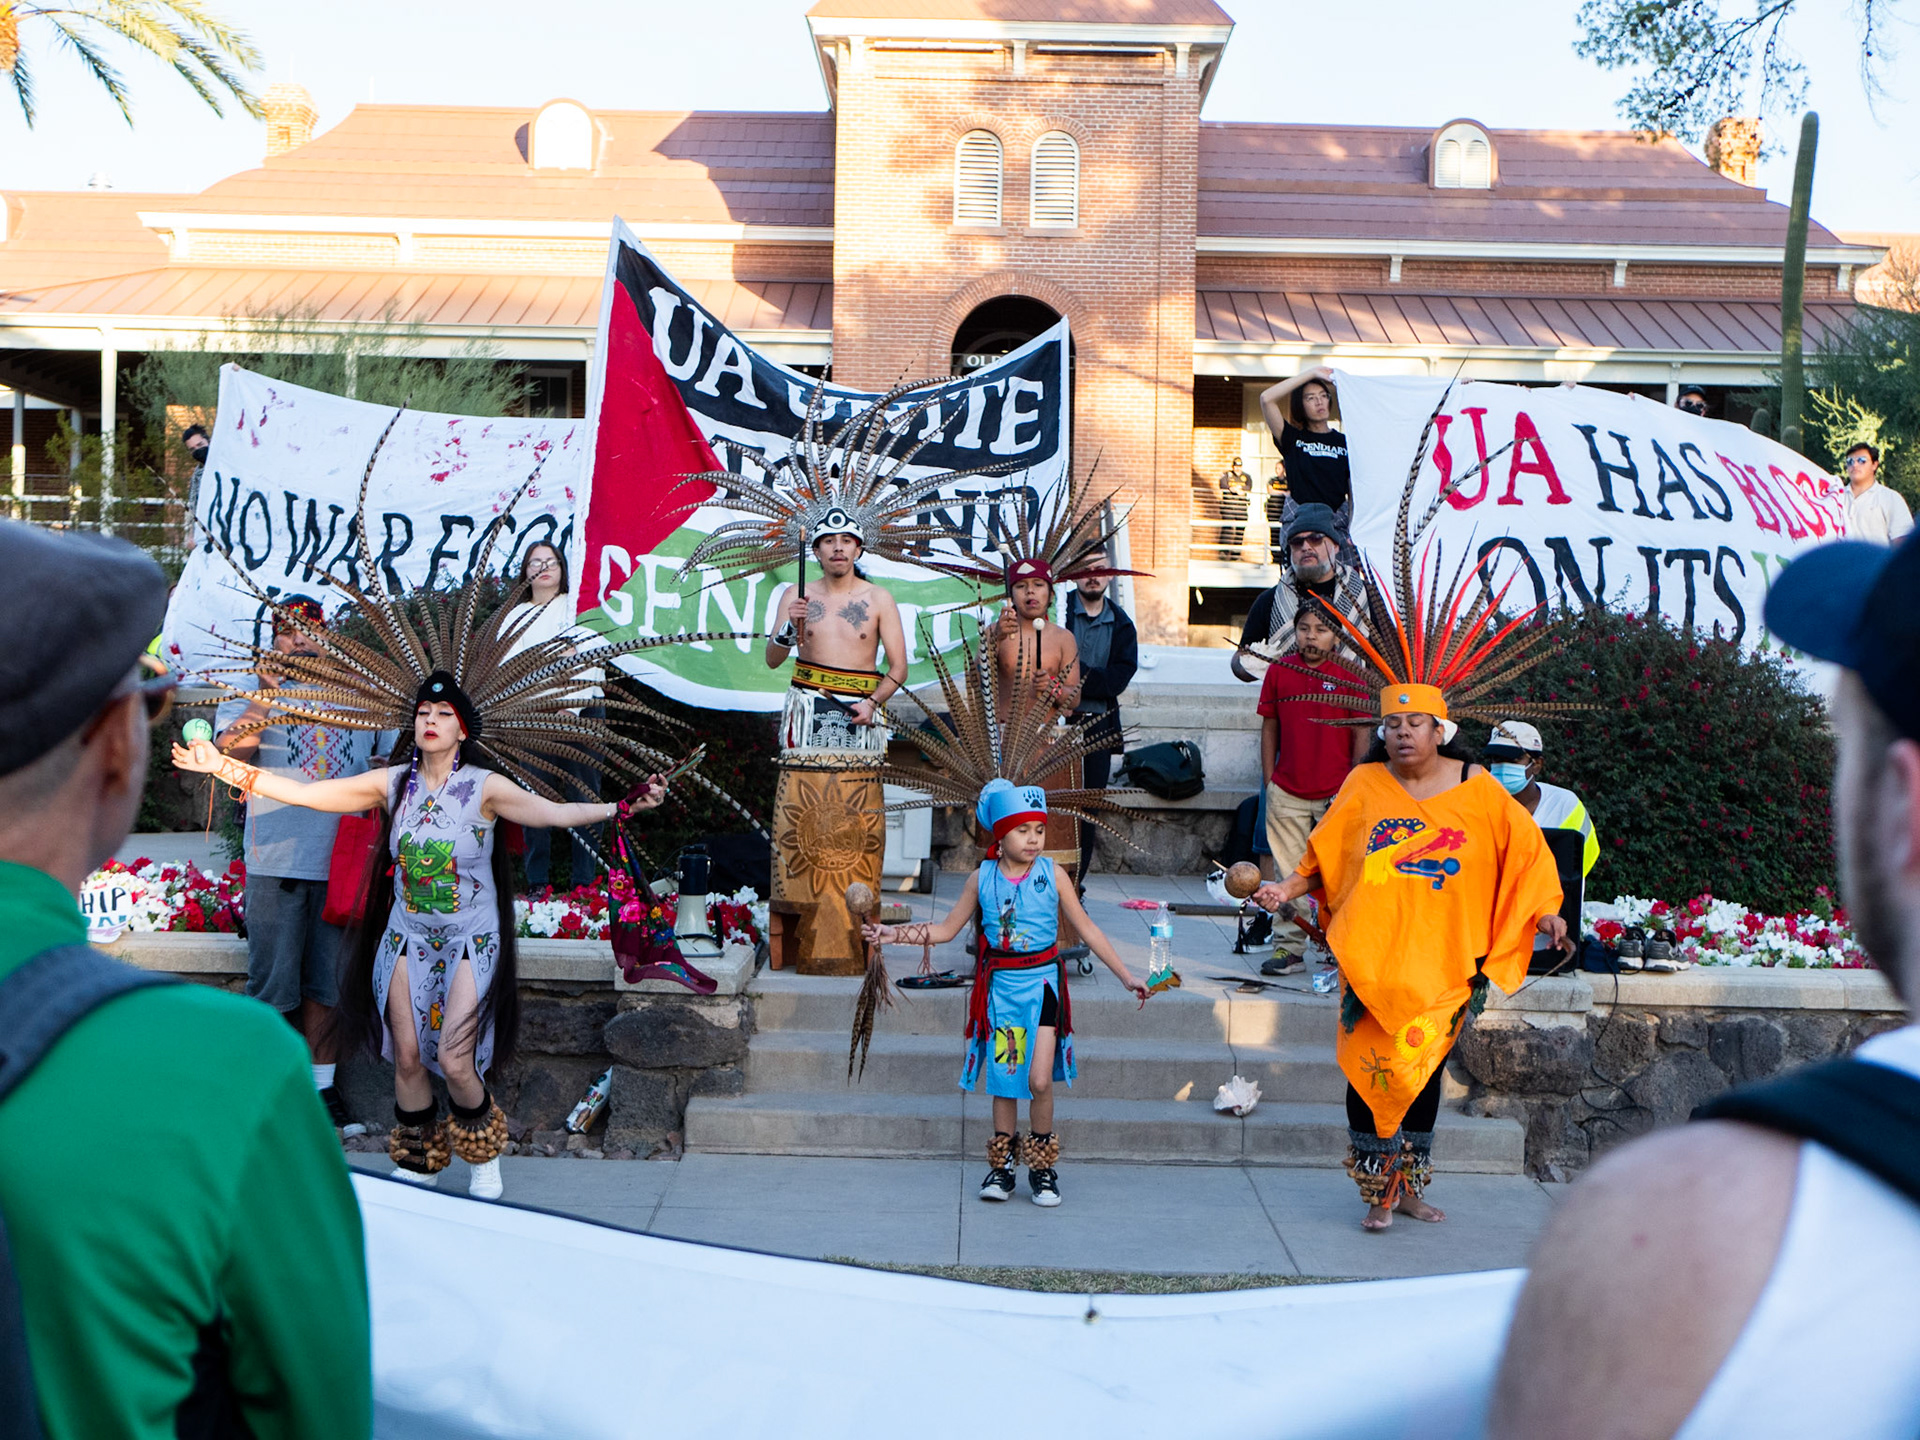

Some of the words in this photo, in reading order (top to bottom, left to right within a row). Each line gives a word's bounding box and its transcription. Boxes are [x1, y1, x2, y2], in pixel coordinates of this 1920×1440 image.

[649, 286, 767, 410] UA
[1432, 407, 1573, 511] UA
[1571, 423, 1733, 522] HAS
[203, 471, 272, 571] NO
[284, 489, 414, 597] WAR
[1477, 536, 1613, 628] ON
[1637, 545, 1746, 645] ITS
